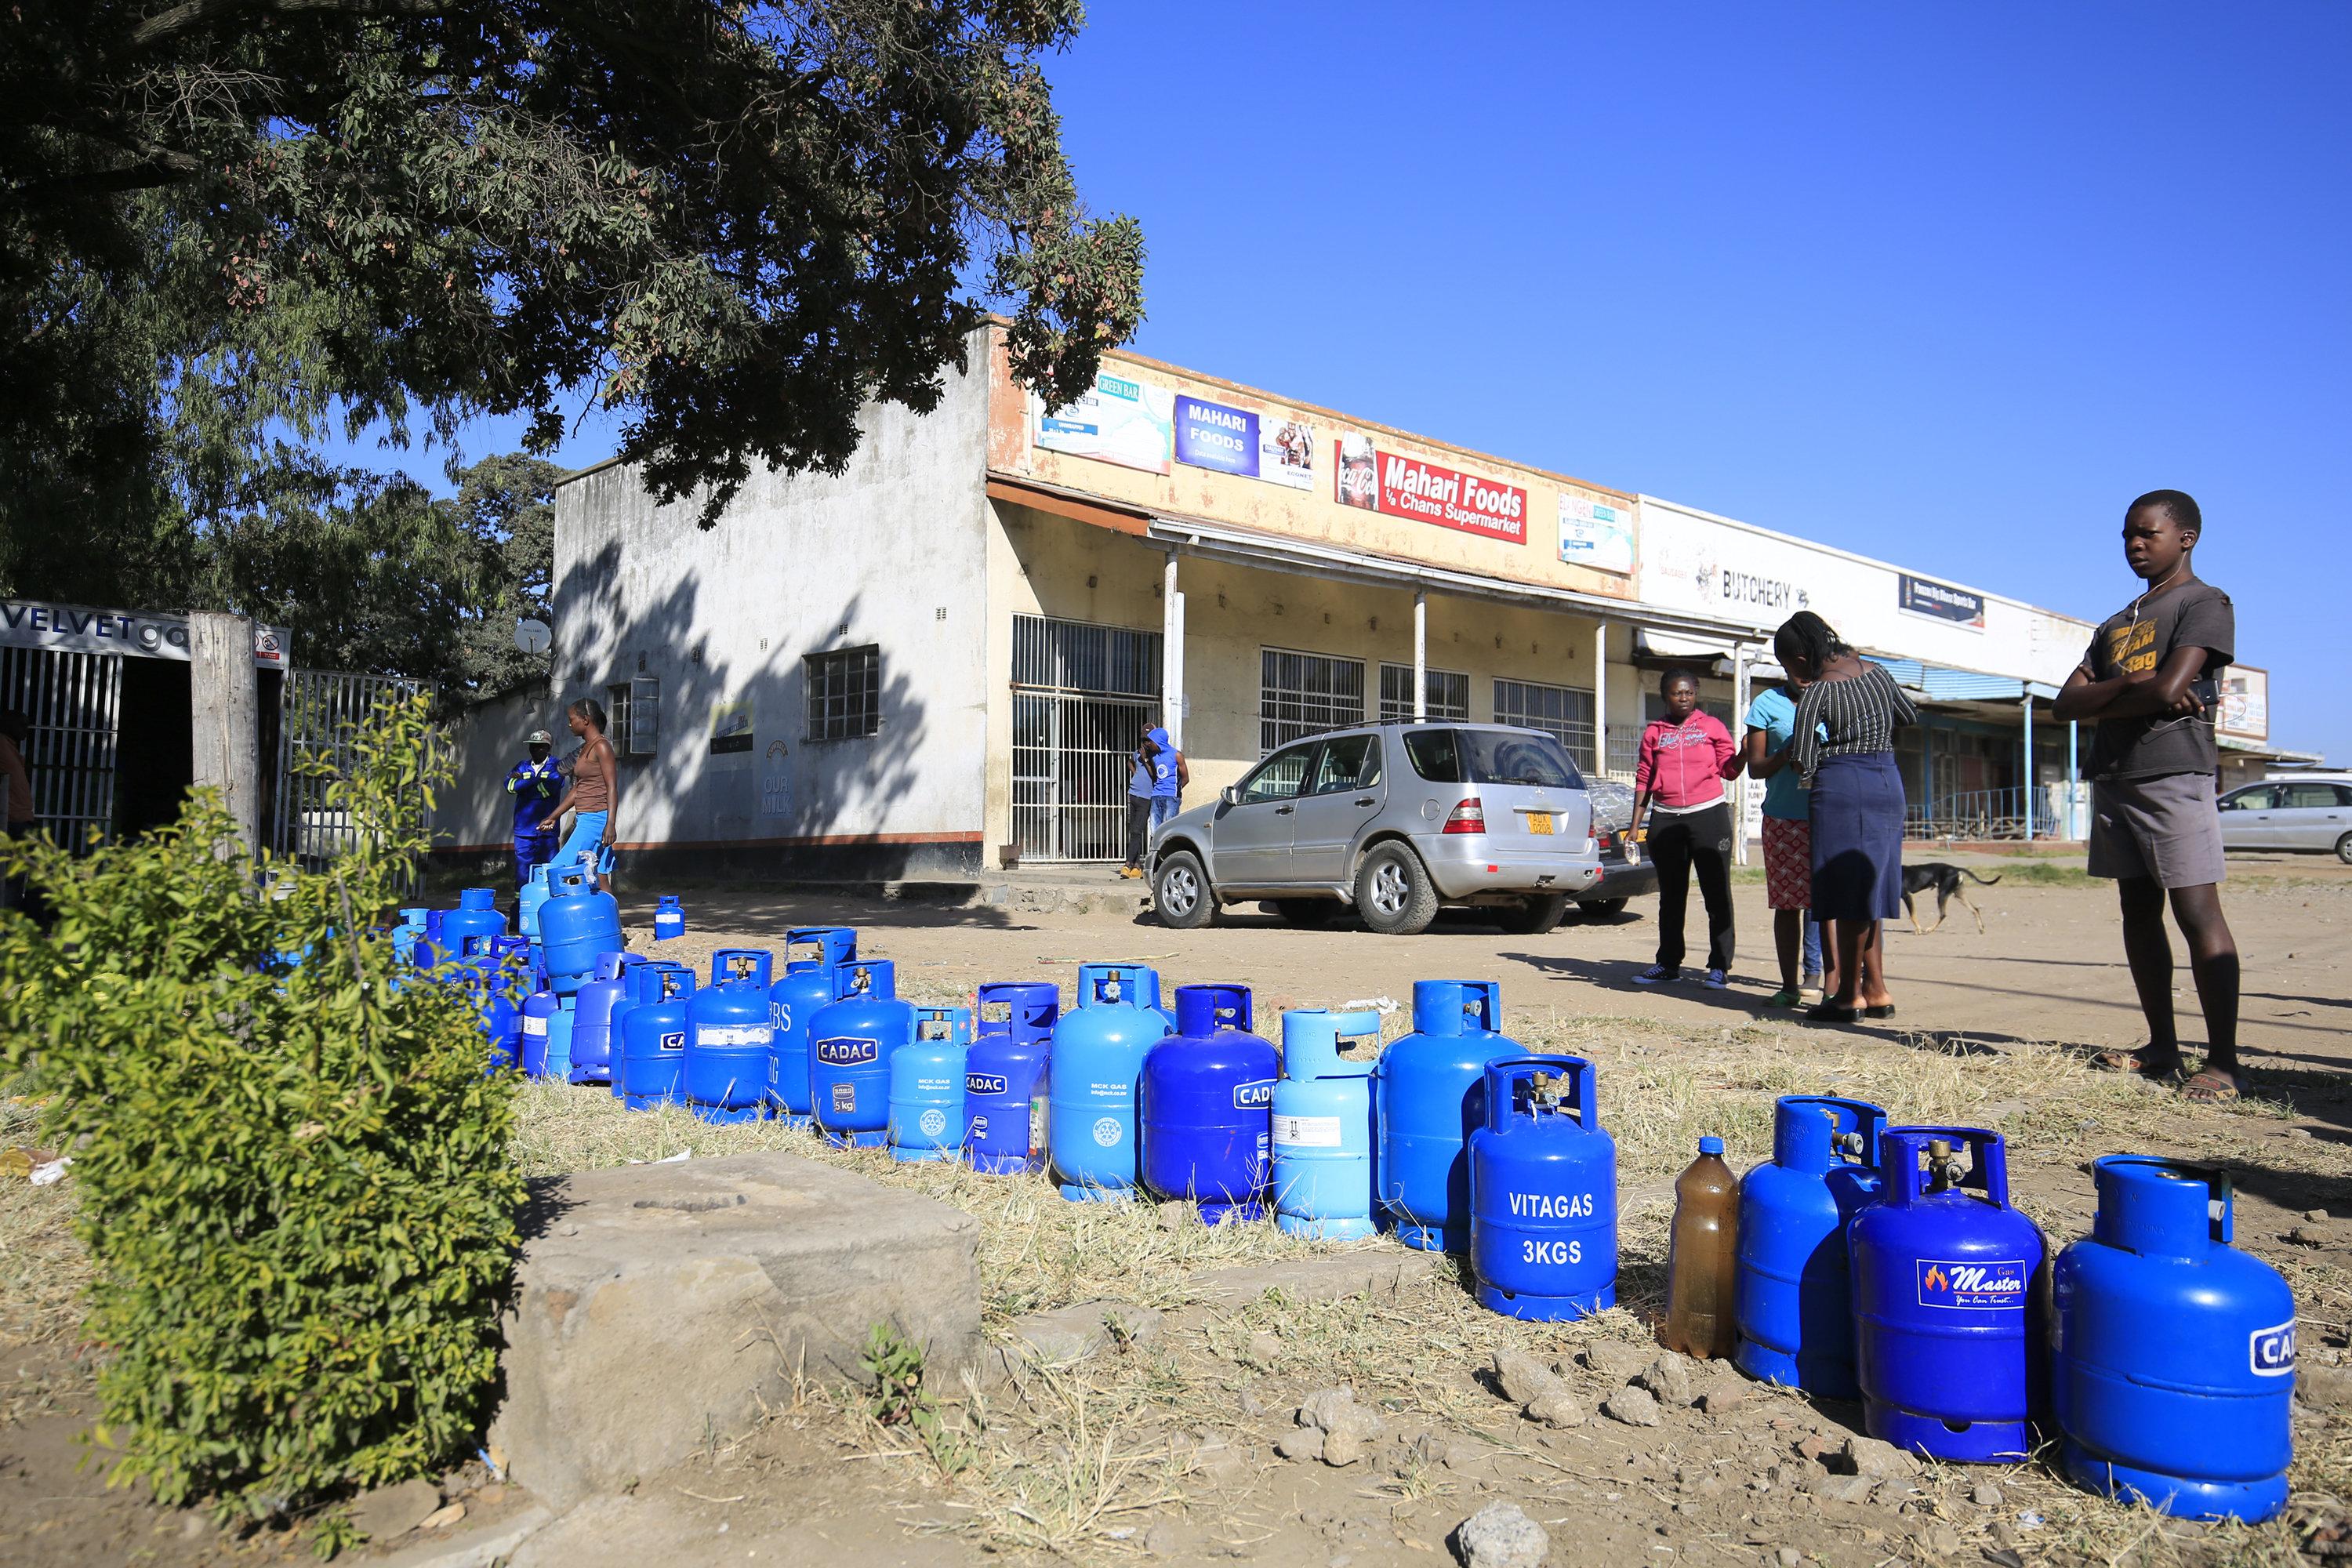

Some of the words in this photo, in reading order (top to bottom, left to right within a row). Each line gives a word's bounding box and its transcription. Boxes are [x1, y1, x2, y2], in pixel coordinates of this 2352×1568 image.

[1099, 377, 1122, 395] GREEN
[1123, 383, 1138, 399] BAR
[1189, 404, 1247, 433] MAHARI
[1190, 426, 1244, 452] FOODS
[1099, 449, 1113, 458] YOUR
[1207, 450, 1225, 462] available
[1225, 455, 1236, 463] here
[1287, 470, 1312, 480] ECONET
[1384, 456, 1460, 503] Mahari
[1463, 477, 1522, 517] Foods
[1386, 488, 1396, 506] t/a
[1400, 492, 1442, 517] Chans
[1445, 503, 1521, 535] Supermarket
[1661, 565, 1688, 579] SAUSAGES
[1722, 569, 1791, 610] BUTCHERY
[1, 604, 135, 640] VELVET
[138, 624, 190, 652] ga
[768, 741, 786, 757] COWBELL
[764, 777, 789, 793] OUR
[762, 796, 792, 815] MILK
[1533, 814, 1547, 823] ADX
[1533, 824, 1552, 833] 0208
[820, 1043, 872, 1059] CADAC
[966, 1076, 1002, 1091] CADAC
[835, 1101, 840, 1111] 5
[842, 1101, 853, 1112] kg
[974, 1129, 986, 1140] 3kg
[1508, 1192, 1594, 1219] VITAGAS
[1523, 1240, 1582, 1265] 3KGS
[1950, 1265, 2021, 1292] Master
[1997, 1267, 2015, 1276] Gas
[1956, 1295, 1970, 1306] You
[1973, 1295, 1987, 1304] Can
